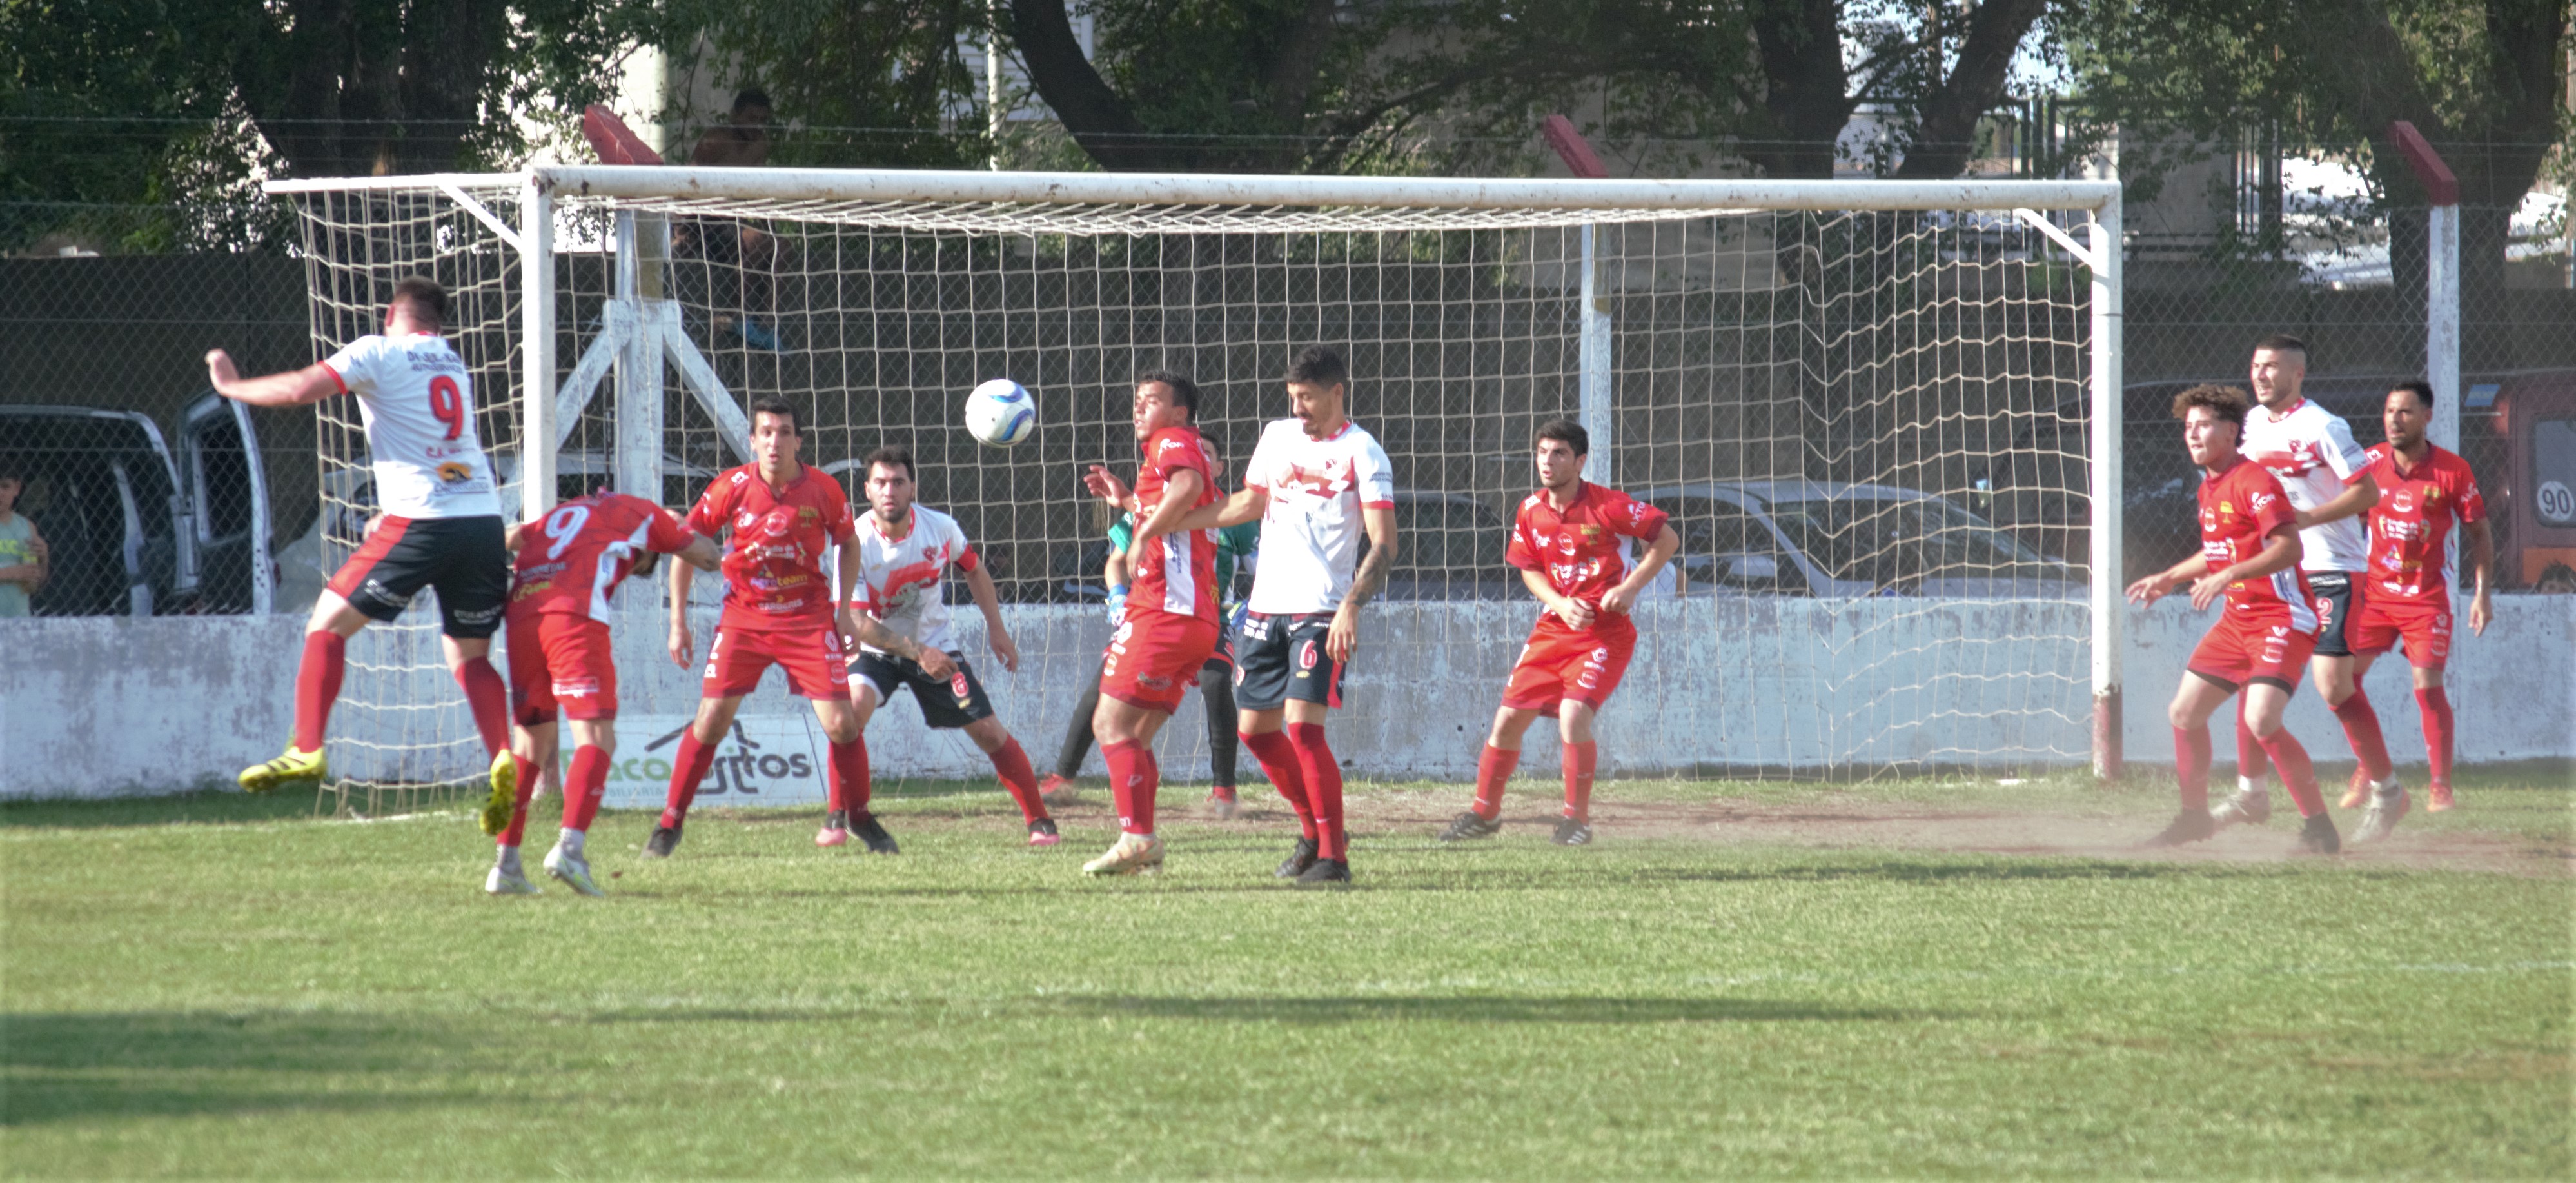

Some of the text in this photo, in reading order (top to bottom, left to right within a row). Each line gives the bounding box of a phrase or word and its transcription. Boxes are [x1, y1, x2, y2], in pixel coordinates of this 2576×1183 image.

[428, 374, 464, 441] 9
[2542, 488, 2570, 514] 90
[545, 505, 591, 561] 9
[2316, 597, 2334, 624] 2
[1299, 639, 1318, 670] 6
